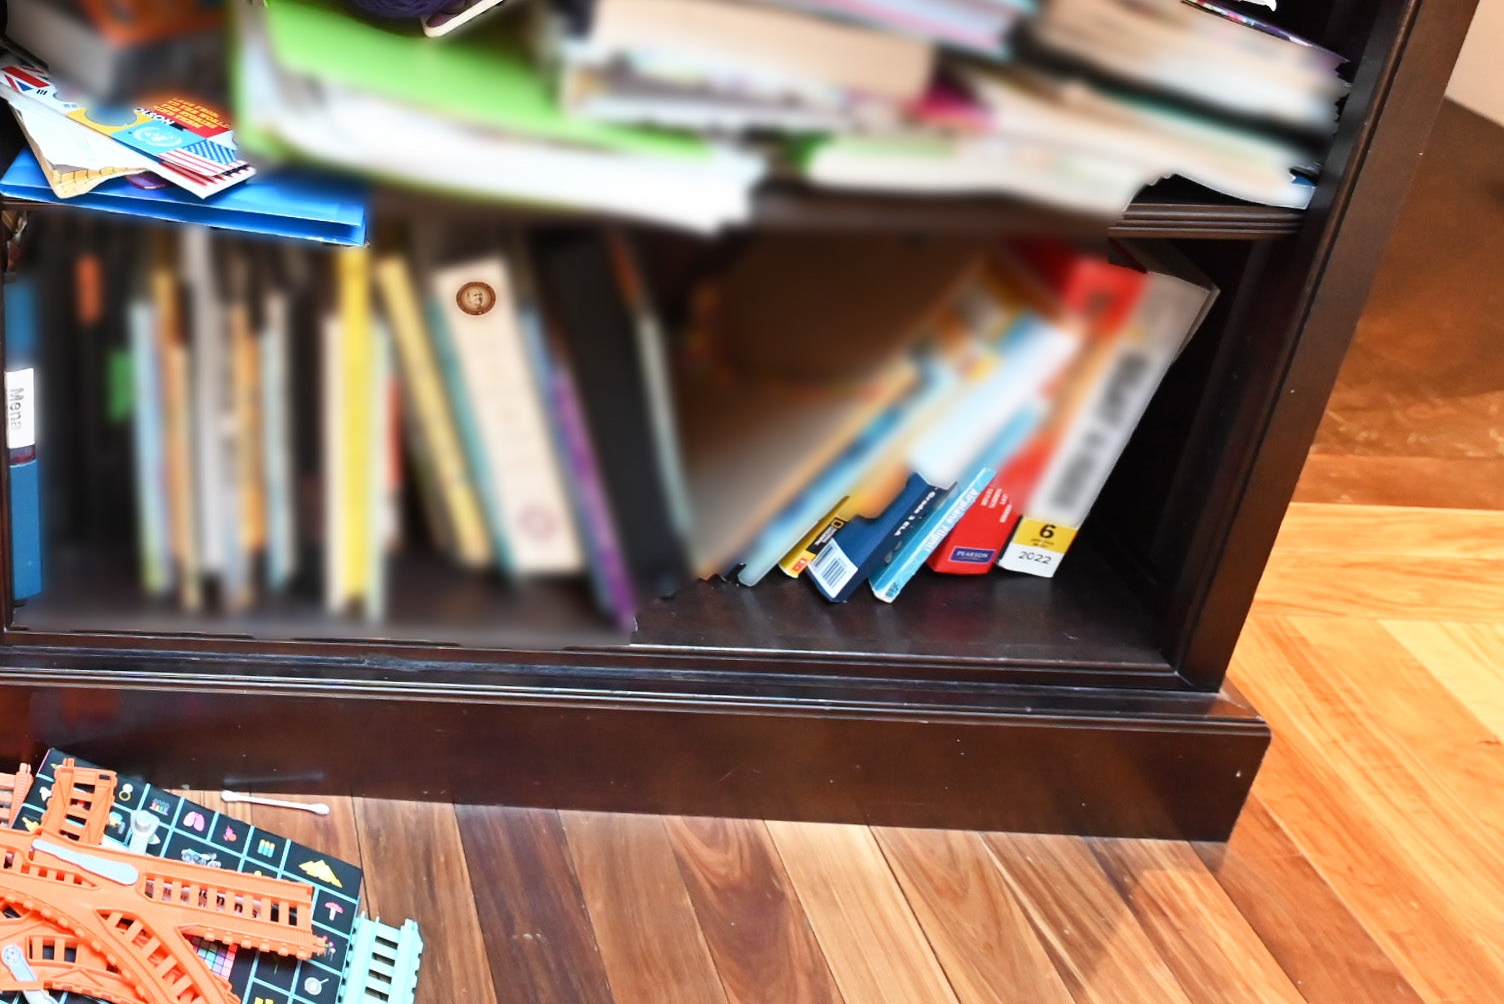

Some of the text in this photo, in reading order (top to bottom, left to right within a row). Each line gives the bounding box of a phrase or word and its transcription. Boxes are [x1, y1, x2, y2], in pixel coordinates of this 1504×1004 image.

[10, 387, 25, 430] Mena
[1040, 524, 1056, 539] 6
[956, 550, 989, 559] PEARSON
[1018, 550, 1052, 565] 2022
